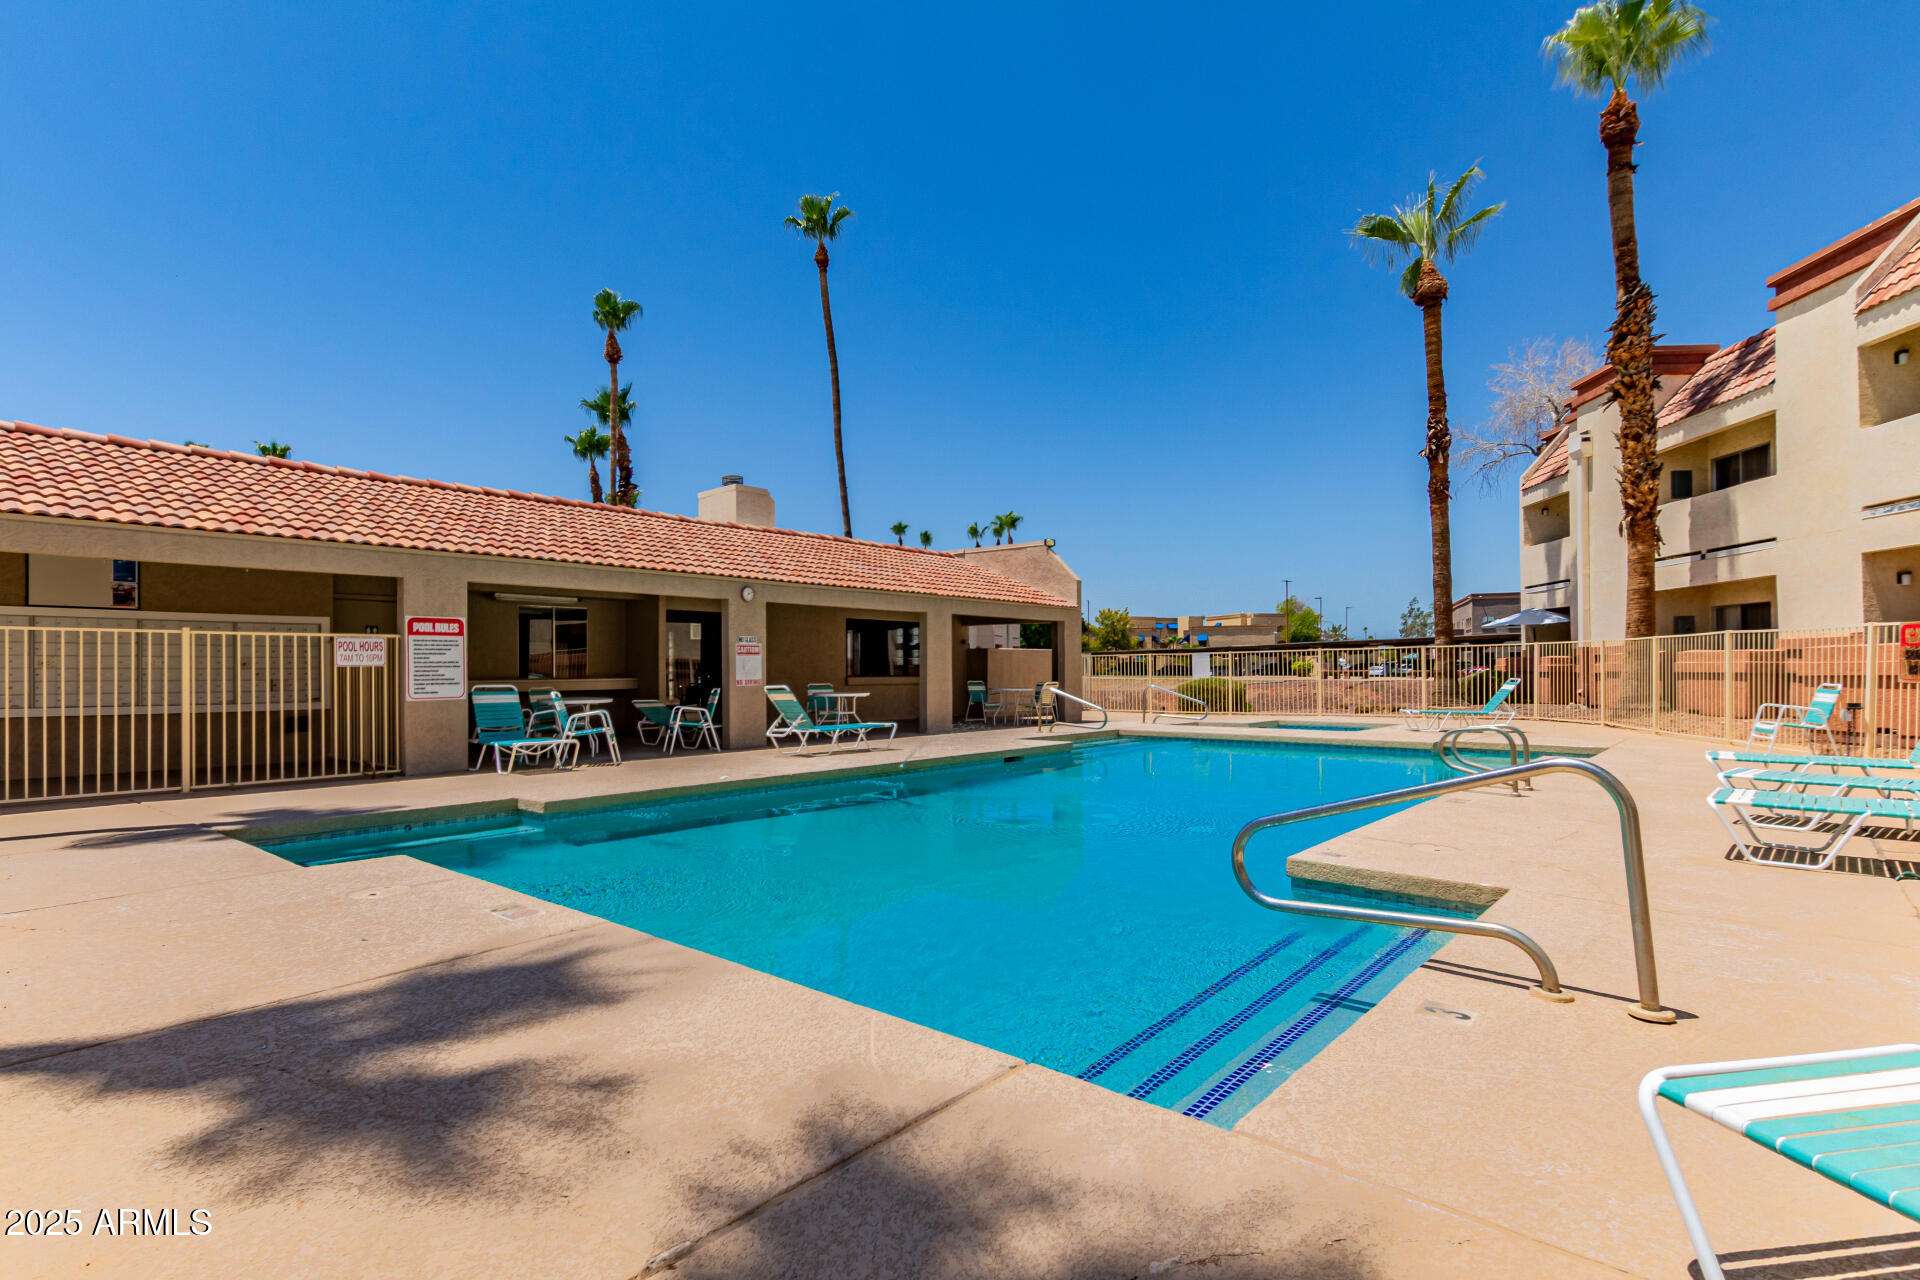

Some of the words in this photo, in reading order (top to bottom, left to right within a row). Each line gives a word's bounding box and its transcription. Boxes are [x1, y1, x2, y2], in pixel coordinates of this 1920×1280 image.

[412, 622, 434, 632] POOL
[435, 622, 459, 633] RULES
[338, 641, 358, 652] POOL
[359, 641, 383, 652] HOURS
[340, 654, 353, 662] 7AM
[354, 654, 364, 662] TO
[366, 654, 382, 662] 10PM
